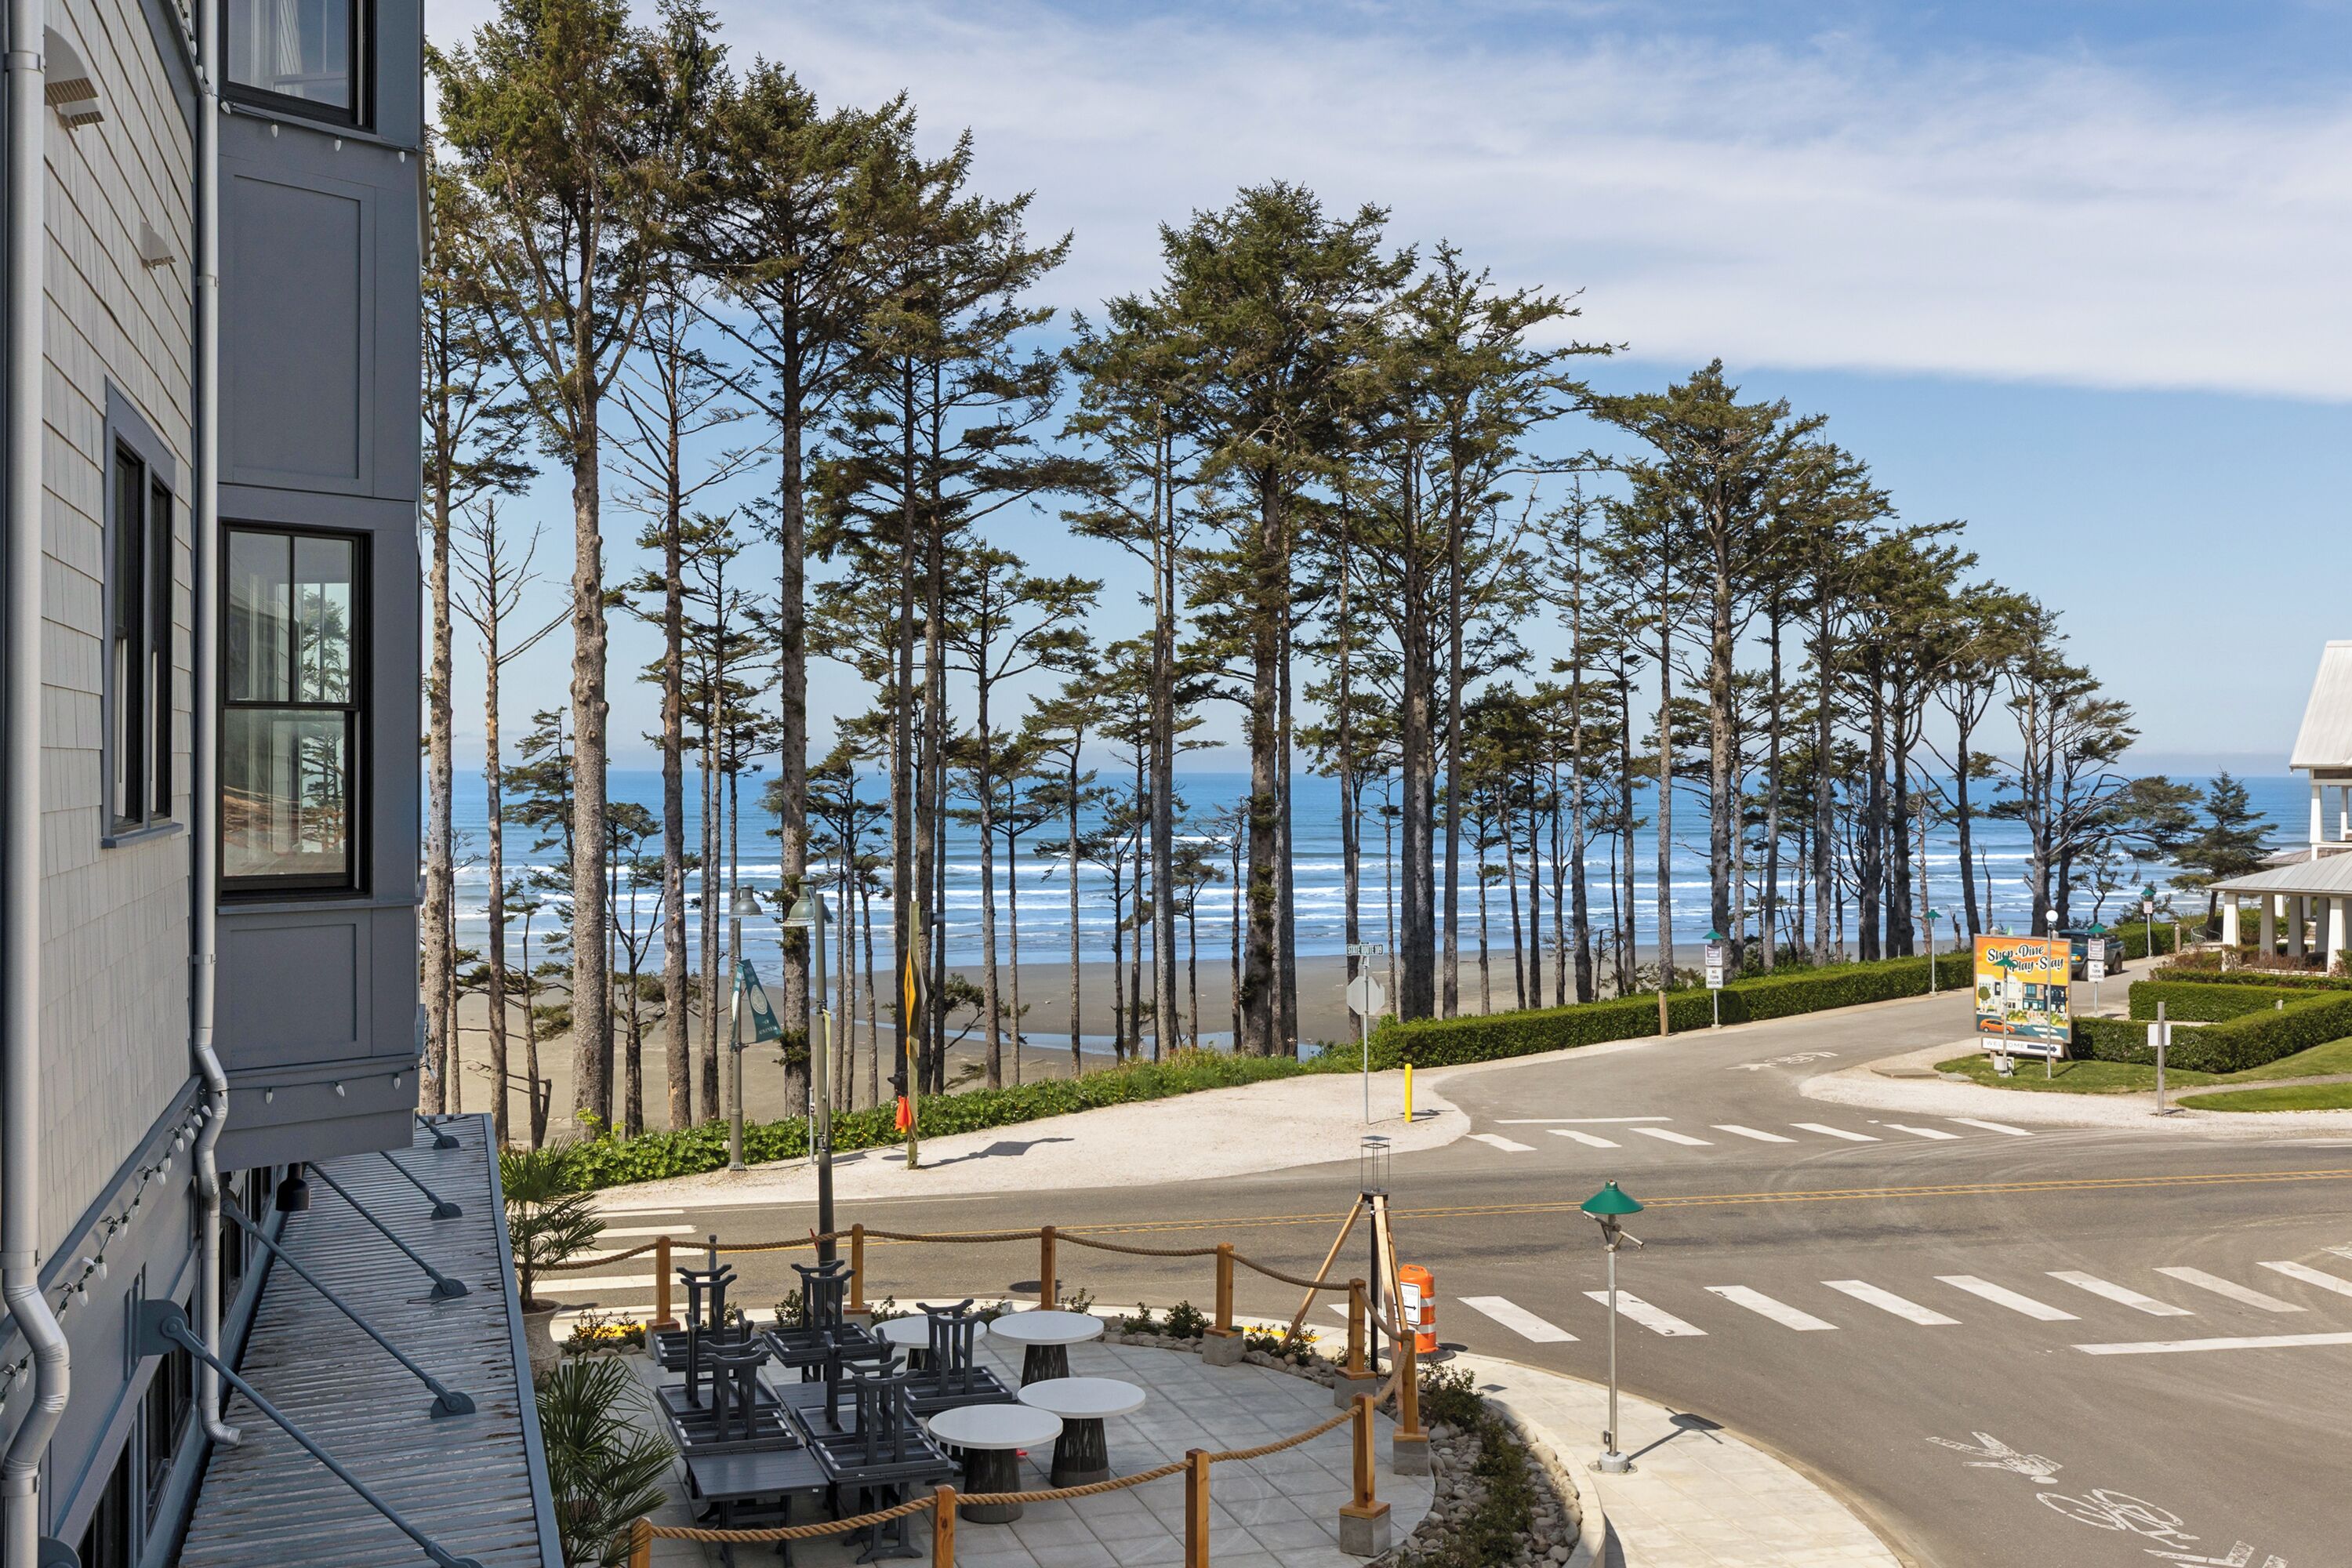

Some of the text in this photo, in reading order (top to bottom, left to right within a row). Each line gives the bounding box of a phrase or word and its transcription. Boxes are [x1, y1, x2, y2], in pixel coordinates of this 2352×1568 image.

[1348, 946, 1360, 954] STATE
[1361, 946, 1374, 954] ROUTE
[2019, 945, 2044, 957] Dine
[2039, 956, 2063, 969] Say
